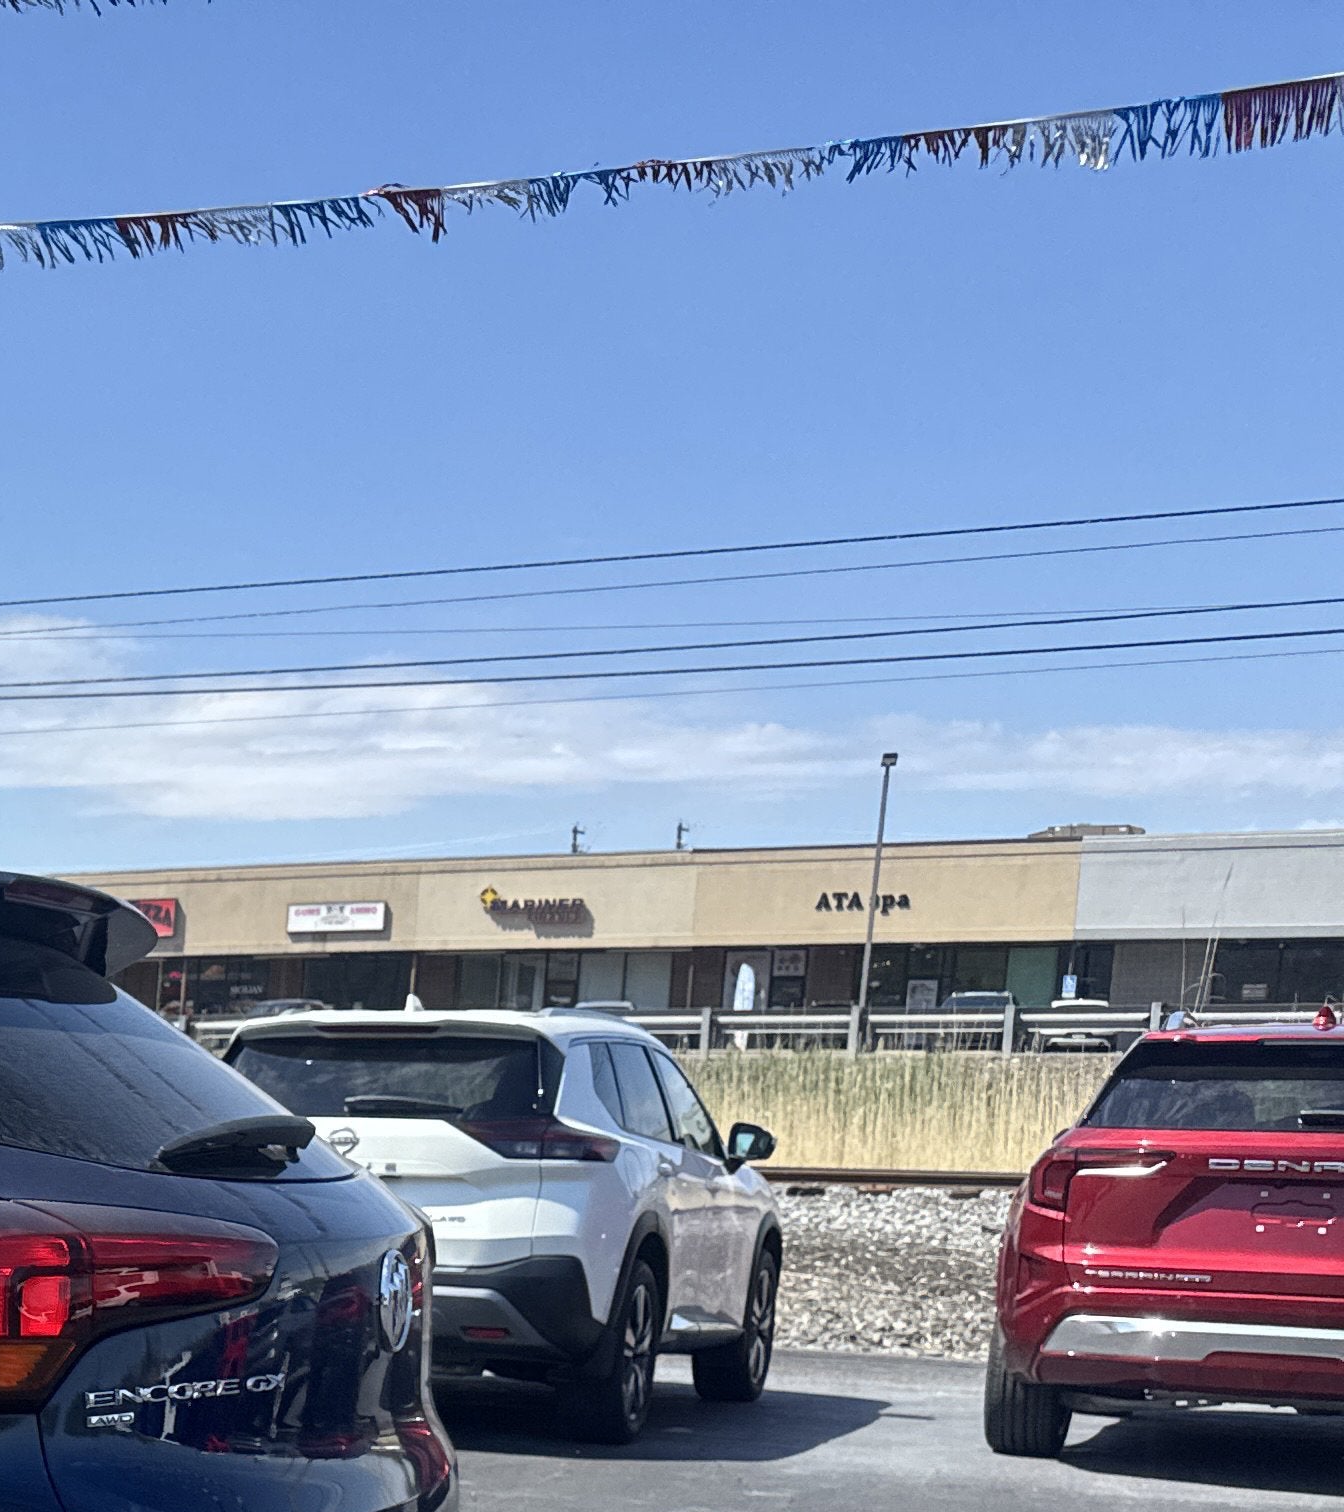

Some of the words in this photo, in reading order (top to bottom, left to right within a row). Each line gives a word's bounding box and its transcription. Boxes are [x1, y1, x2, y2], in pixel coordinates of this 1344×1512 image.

[816, 892, 863, 912] ATA
[85, 1379, 240, 1409] ENCORE
[246, 1373, 285, 1392] GX
